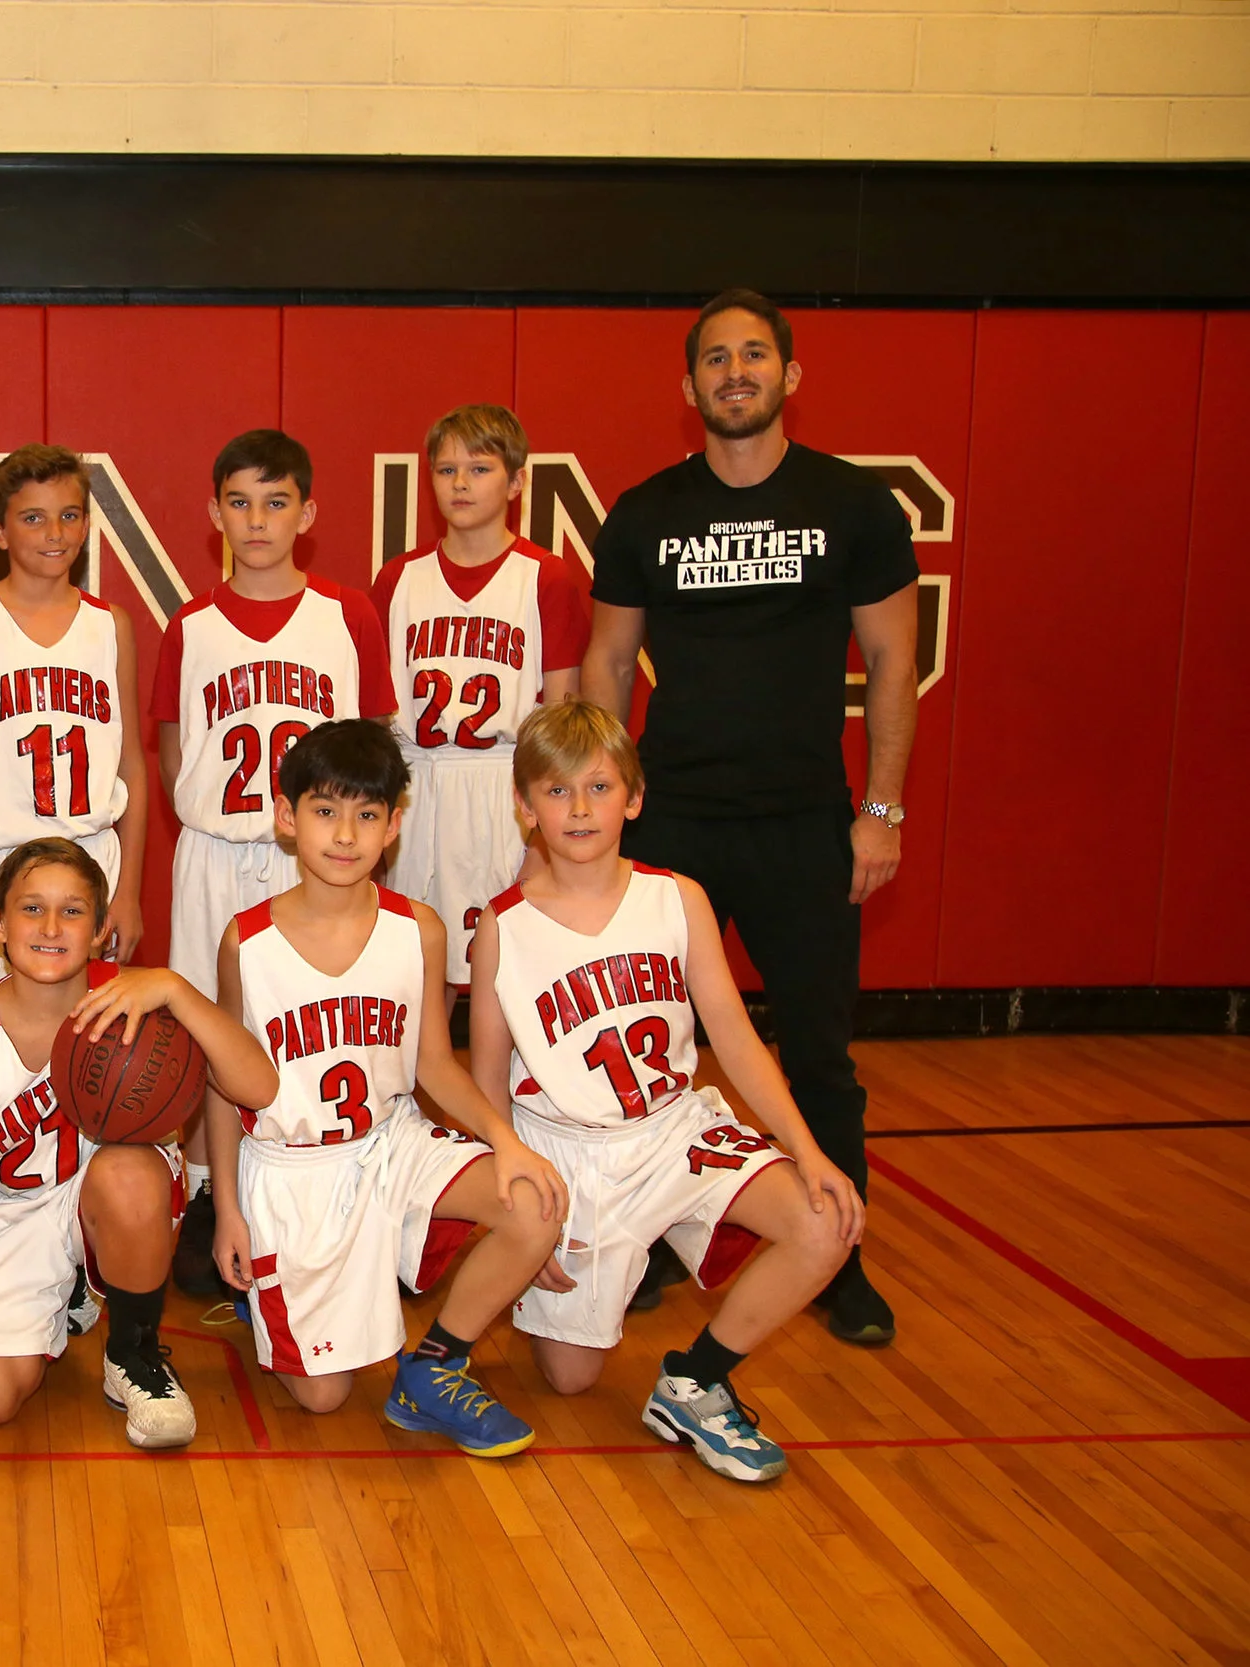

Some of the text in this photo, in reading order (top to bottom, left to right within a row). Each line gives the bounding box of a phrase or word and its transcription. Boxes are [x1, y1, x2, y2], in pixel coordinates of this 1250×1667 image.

[658, 528, 827, 566] PANTHER
[709, 519, 775, 535] BROWNING
[682, 560, 799, 585] ATHLETICS
[406, 616, 525, 671] PANTHERS
[203, 660, 334, 731] PANTHERS
[413, 669, 501, 750] 22
[17, 724, 91, 817] 11
[266, 996, 407, 1072] PANTHERS
[535, 952, 687, 1048] PANTHERS
[320, 1060, 373, 1146] 3
[583, 1015, 690, 1120] 13
[686, 1125, 772, 1176] 13
